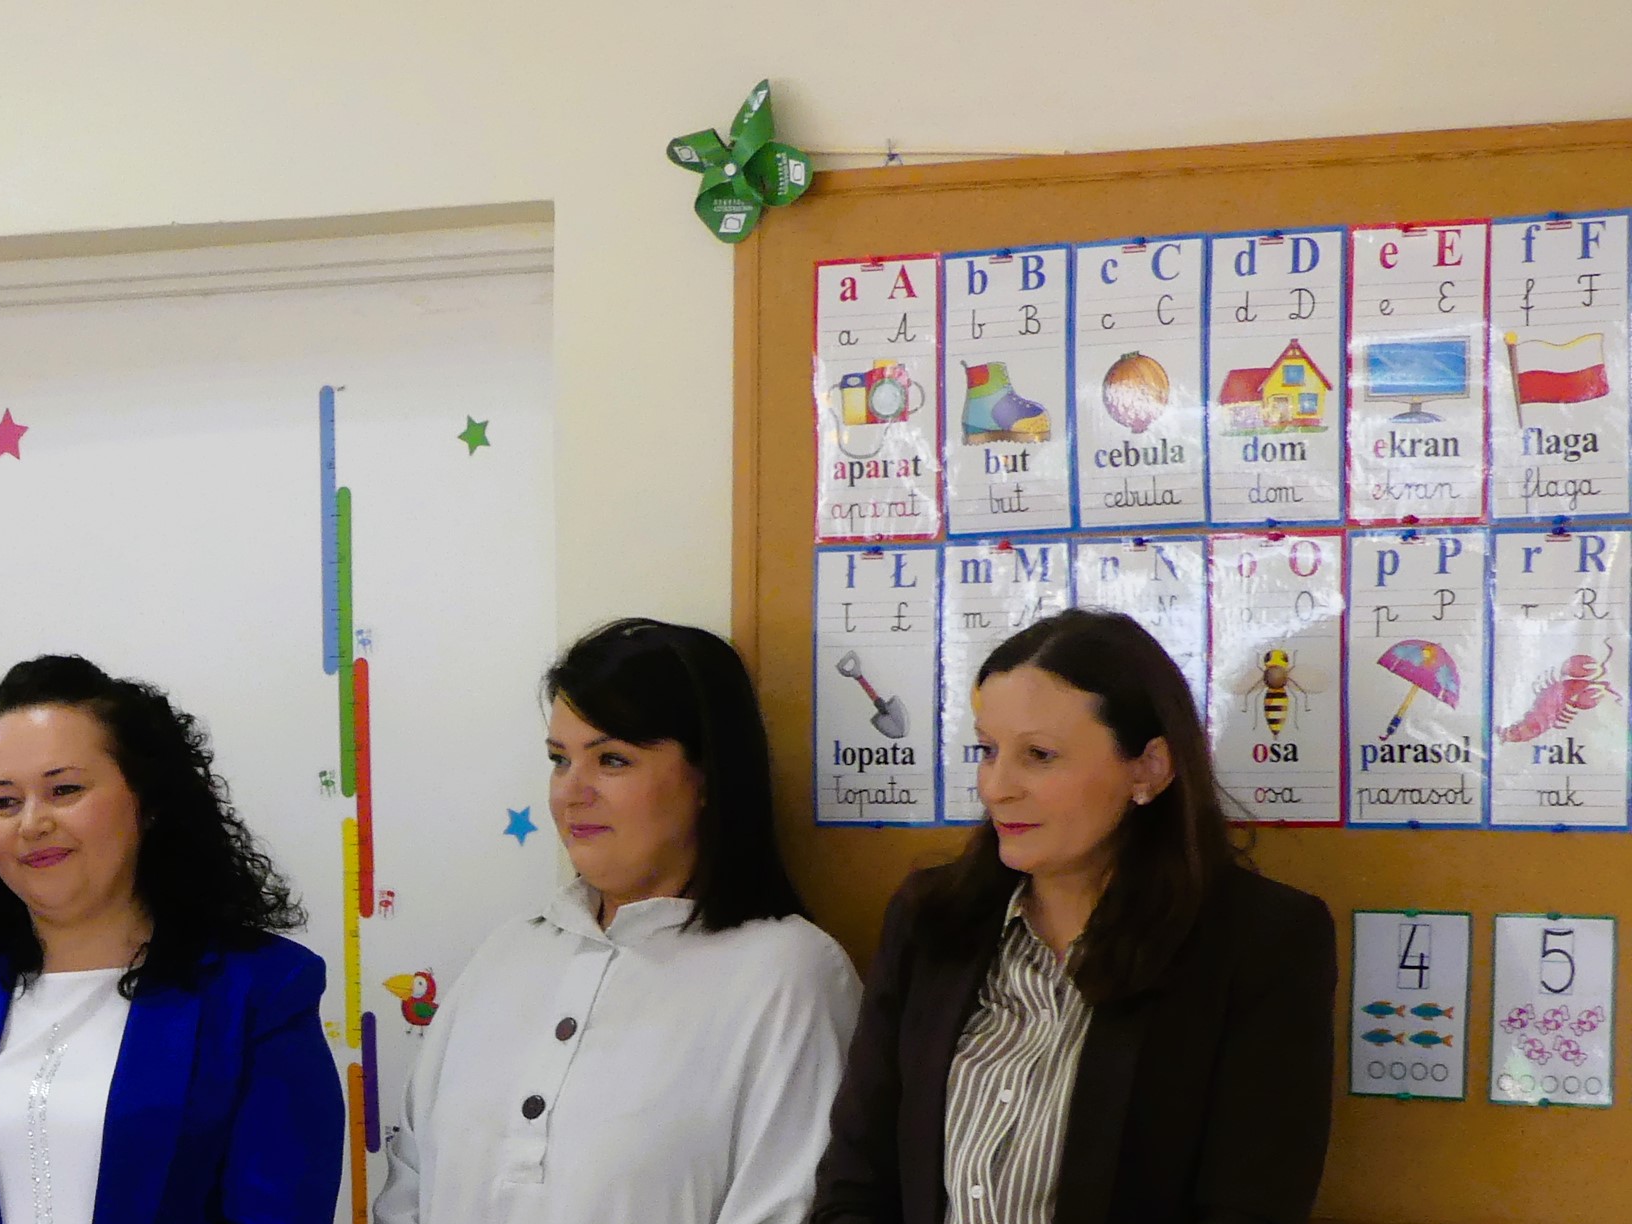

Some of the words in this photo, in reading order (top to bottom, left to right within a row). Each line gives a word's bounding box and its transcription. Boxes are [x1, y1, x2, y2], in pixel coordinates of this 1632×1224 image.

[1234, 240, 1257, 277] d
[1288, 237, 1320, 274] D
[1379, 242, 1399, 269] e
[1433, 229, 1463, 267] E
[1521, 225, 1541, 263] f
[1578, 221, 1606, 260] F
[967, 261, 987, 295] b
[1019, 255, 1046, 291] B
[1100, 258, 1118, 284] c
[1151, 244, 1181, 281] C
[840, 277, 858, 302] a
[888, 265, 918, 299] A
[1521, 279, 1535, 326] f
[1578, 273, 1601, 307] F
[972, 309, 986, 339] b
[1018, 305, 1041, 335] B
[1101, 313, 1116, 330] c
[1157, 295, 1175, 326] C
[1235, 291, 1257, 322] d
[1289, 288, 1316, 320] D
[1379, 299, 1394, 316] e
[838, 329, 859, 347] a
[887, 313, 916, 343] A
[984, 448, 1030, 475] but
[1094, 438, 1185, 469] cebula
[1243, 435, 1307, 462] dom
[1373, 431, 1459, 458] ekran
[1521, 427, 1599, 462] flaga
[833, 454, 922, 486] aparat
[989, 483, 1029, 514] but
[1103, 476, 1182, 507] cebula
[1248, 475, 1303, 503] dom
[1372, 474, 1460, 501] ekran
[1521, 468, 1601, 514] flaga
[891, 554, 917, 588] Ł
[960, 558, 992, 584] m
[1012, 547, 1051, 583] M
[1100, 555, 1120, 582] n
[1151, 545, 1180, 581] N
[1238, 551, 1256, 578] o
[1289, 540, 1321, 577] O
[1375, 547, 1400, 587] p
[1434, 537, 1462, 575] P
[1521, 547, 1542, 573] r
[1574, 535, 1608, 573] R
[962, 612, 991, 629] m
[1373, 605, 1398, 637] p
[1432, 590, 1456, 620] P
[1574, 588, 1610, 620] R
[833, 740, 915, 774] łopata
[1253, 738, 1299, 763] osa
[1360, 736, 1471, 770] parasol
[1533, 738, 1586, 765] rak
[1254, 786, 1301, 806] osa
[1357, 774, 1473, 819] parasol
[1537, 776, 1584, 807] rak
[1400, 924, 1430, 988] 4
[1541, 929, 1574, 993] 5
